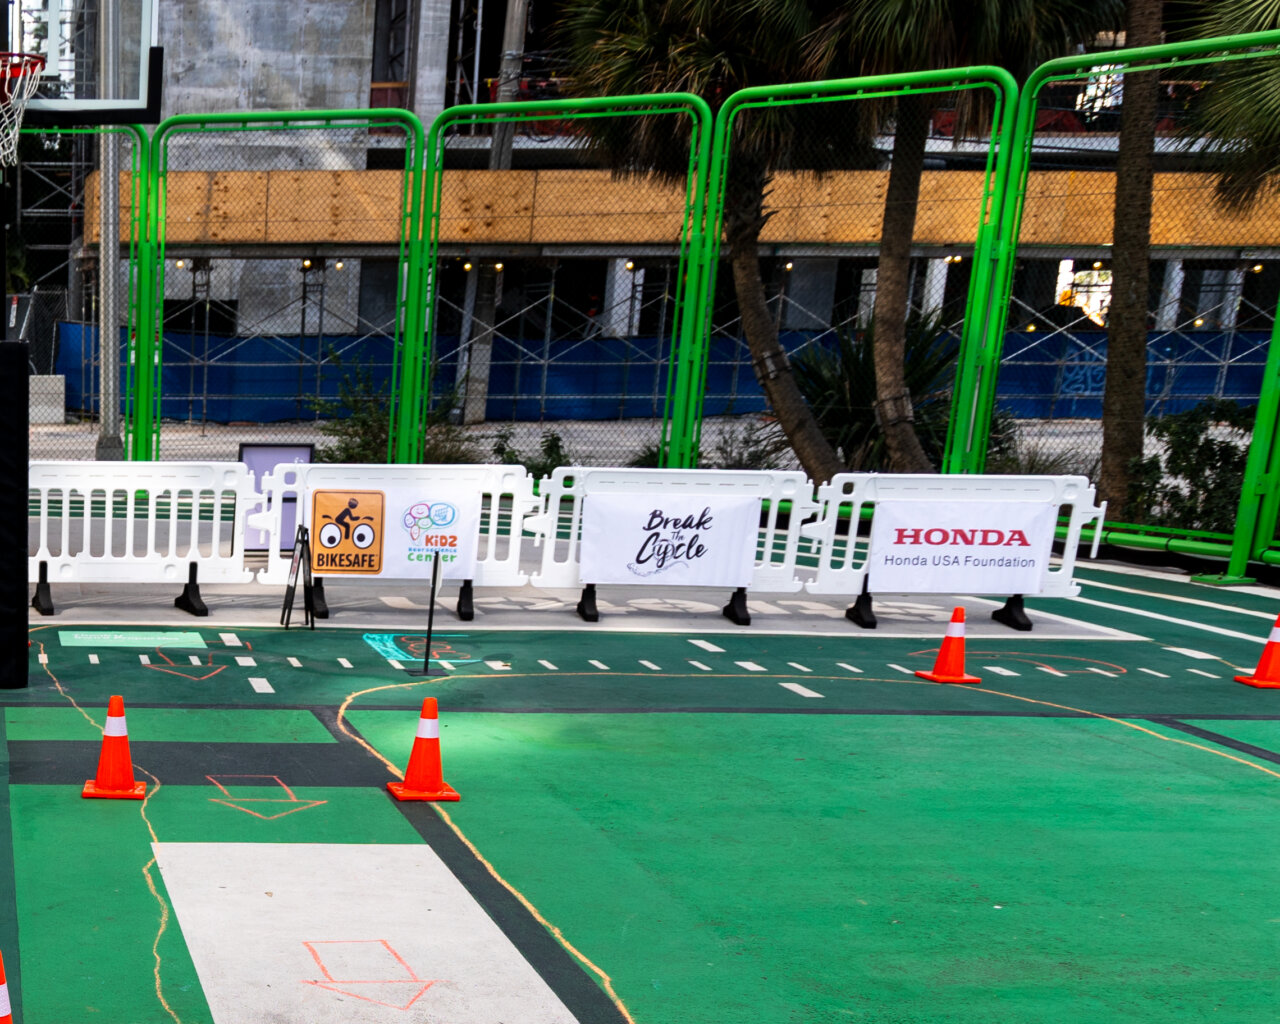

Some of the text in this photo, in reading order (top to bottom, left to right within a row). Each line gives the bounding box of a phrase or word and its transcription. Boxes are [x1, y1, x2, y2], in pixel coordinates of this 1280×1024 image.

[642, 506, 714, 531] Break
[671, 529, 685, 541] The
[893, 528, 1031, 546] HONDA
[407, 552, 458, 562] Cener
[635, 532, 708, 568] Cycle
[317, 553, 375, 568] BIKESAFE
[884, 555, 1036, 568] Honda USA Foundation
